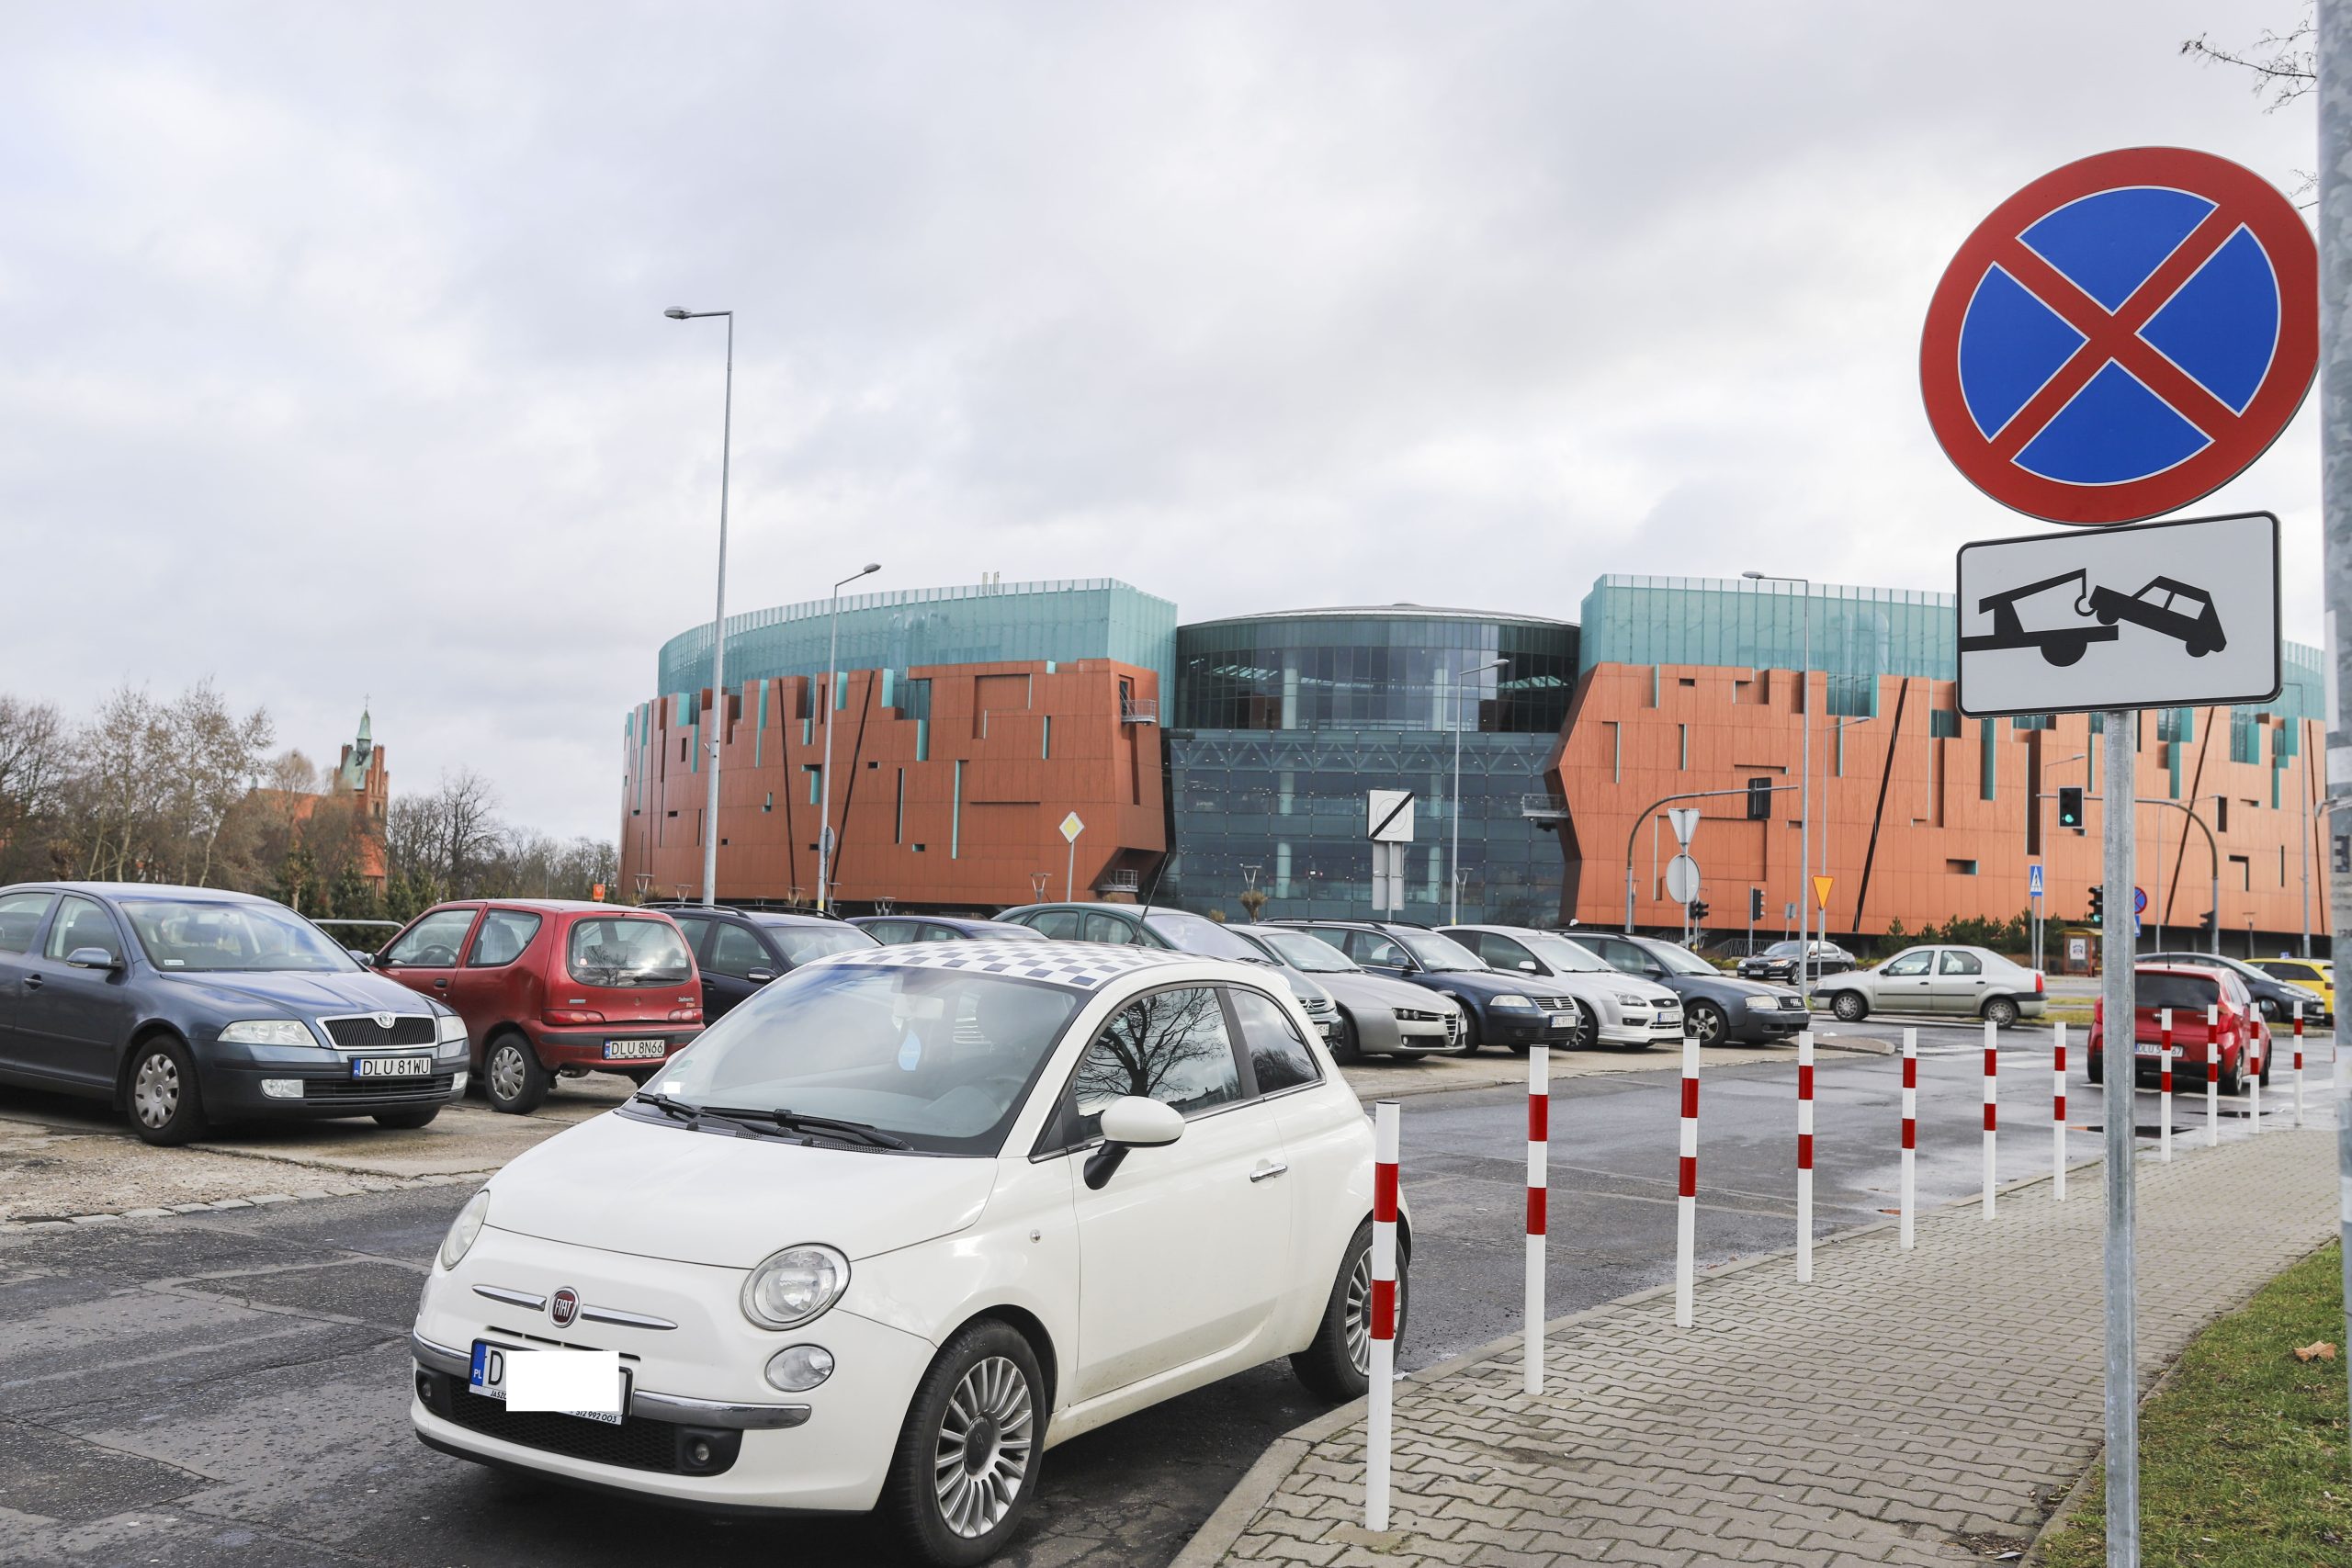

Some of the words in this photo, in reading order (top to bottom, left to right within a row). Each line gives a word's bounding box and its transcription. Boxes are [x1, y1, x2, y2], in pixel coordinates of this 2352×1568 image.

[611, 1042, 636, 1055] DLU
[639, 1041, 663, 1054] 8N66
[2138, 1043, 2154, 1053] DLU
[2156, 1045, 2182, 1055] 567
[363, 1060, 393, 1076] DLU
[398, 1059, 429, 1075] 81WU
[554, 1298, 573, 1317] FIAT
[473, 1368, 482, 1380] PL
[588, 1411, 601, 1420] 992
[602, 1414, 617, 1423] 003
